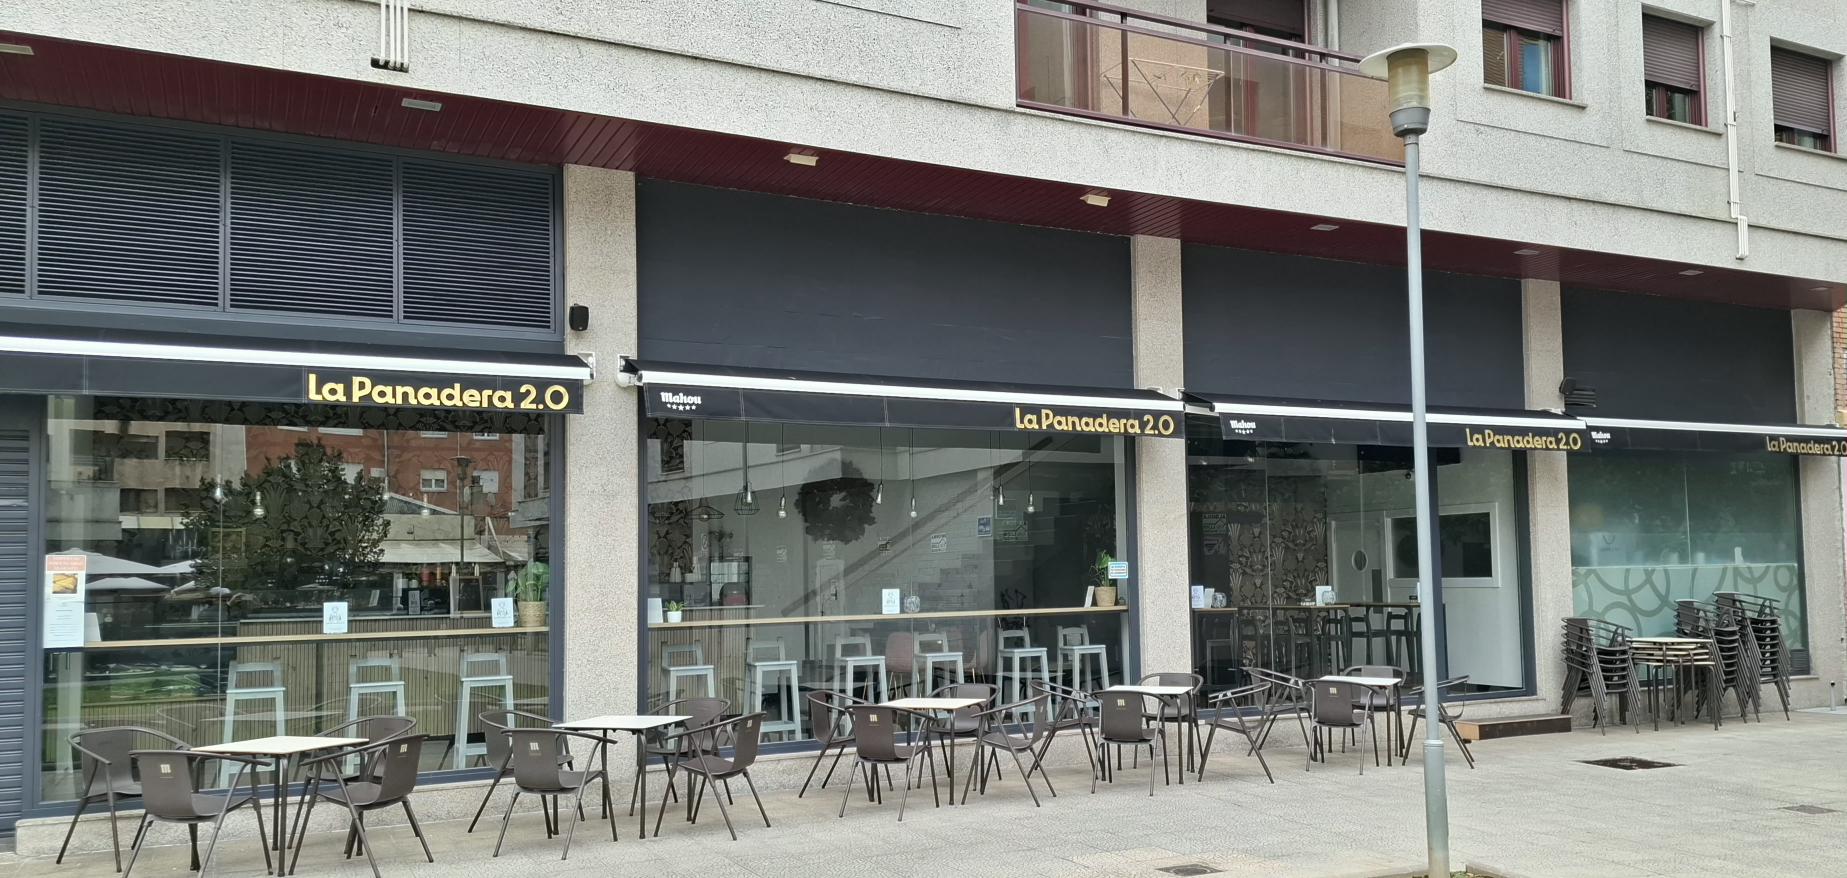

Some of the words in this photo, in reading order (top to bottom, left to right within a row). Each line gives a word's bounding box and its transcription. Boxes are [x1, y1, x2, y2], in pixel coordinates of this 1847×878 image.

[308, 373, 347, 402] La
[351, 376, 515, 410] Panadera
[519, 384, 570, 411] 2.0
[660, 391, 702, 405] Mahou
[1015, 407, 1039, 429] La
[1041, 408, 1141, 434] Panadera
[1143, 414, 1175, 435] 2.0
[1229, 419, 1257, 429] Mahou
[1466, 428, 1484, 446] La
[1484, 429, 1558, 449] Panadera
[1558, 432, 1581, 450] 2.0
[1766, 435, 1779, 452] La
[1779, 436, 1833, 454] Panadera
